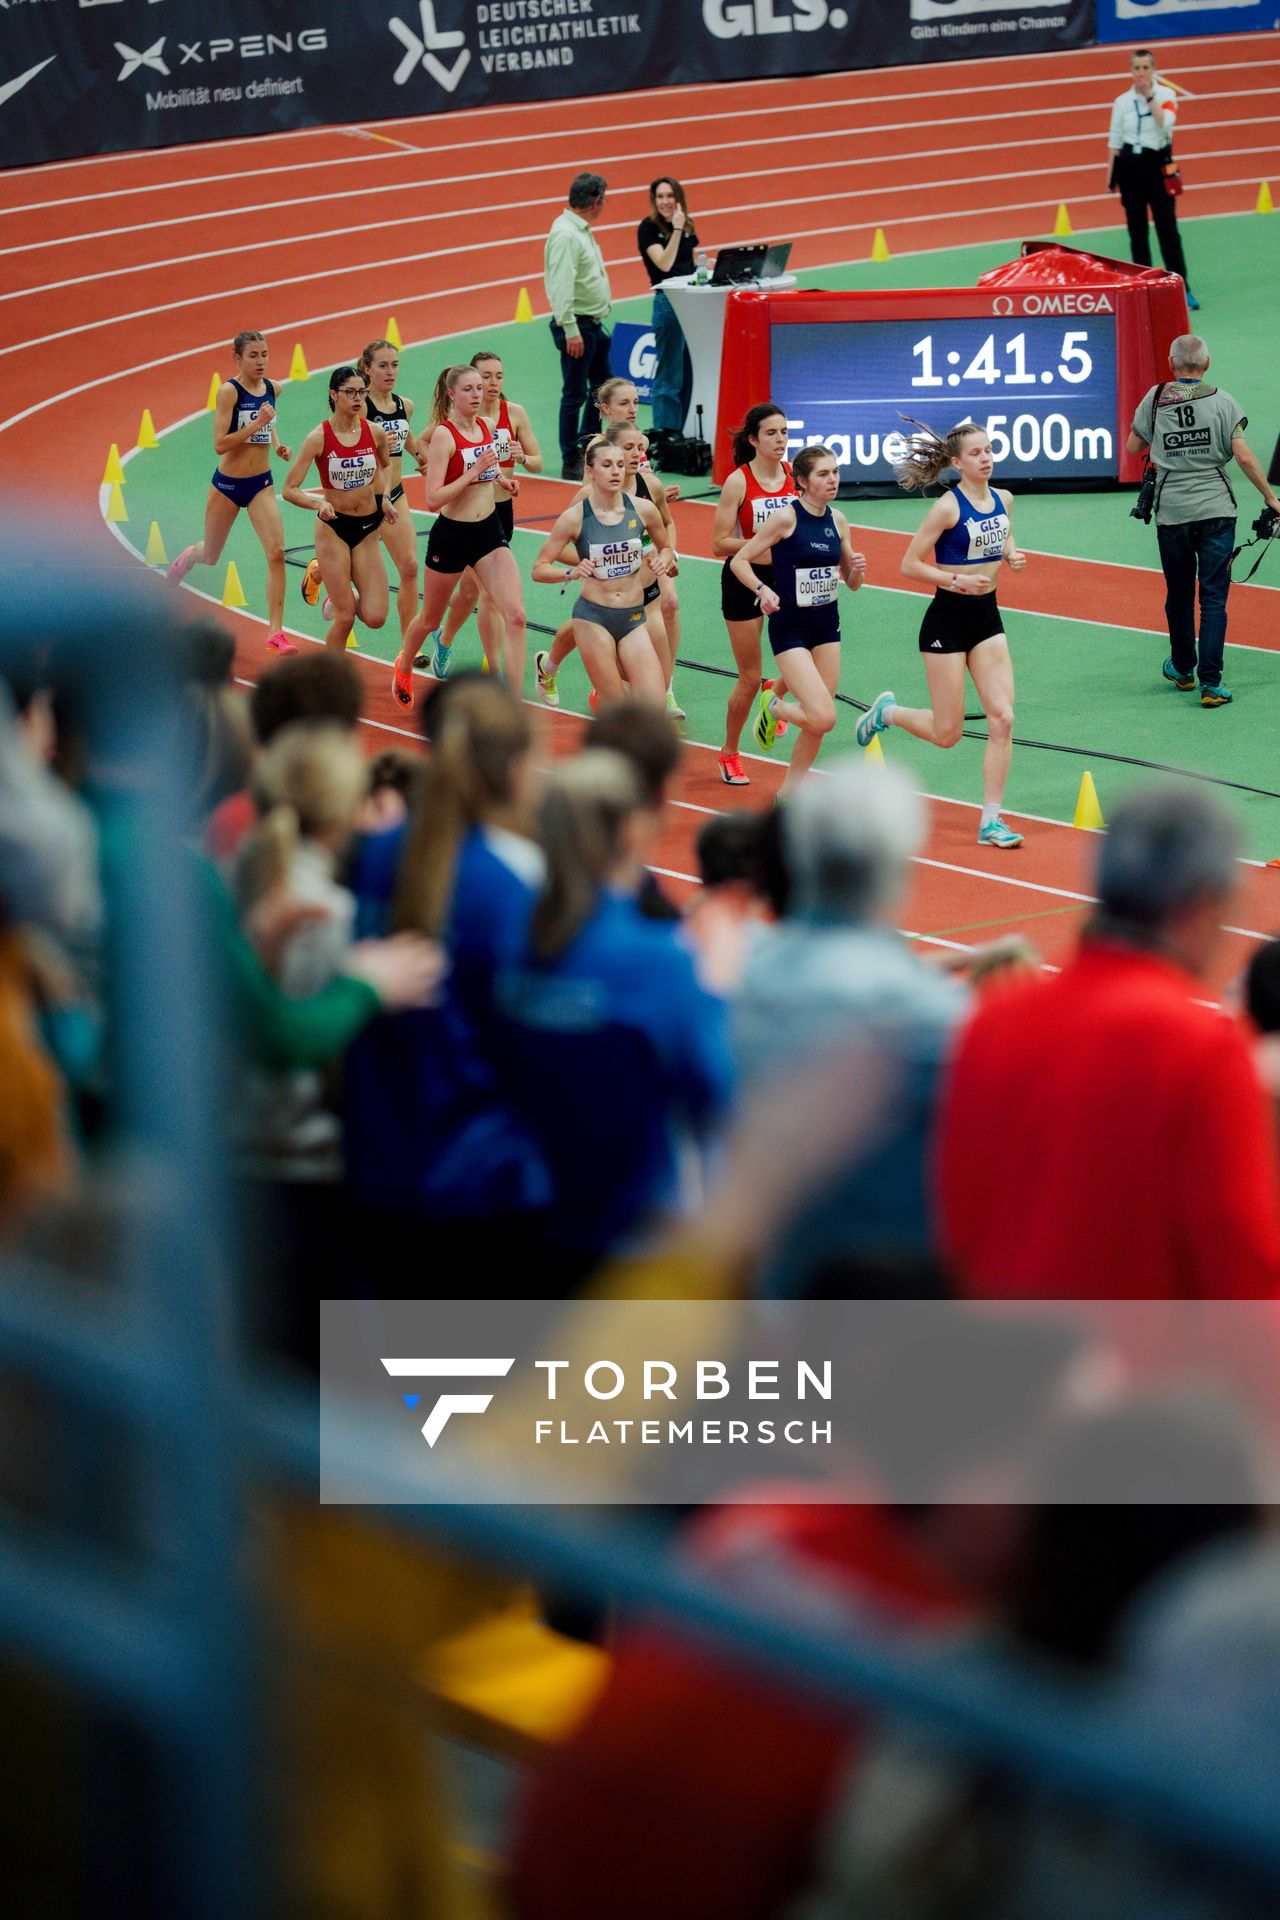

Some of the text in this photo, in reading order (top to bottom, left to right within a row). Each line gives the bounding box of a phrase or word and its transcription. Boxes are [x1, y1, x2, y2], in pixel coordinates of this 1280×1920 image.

[477, 0, 593, 23] DEUTSCHER
[479, 14, 641, 48] LEICHTATHLETIK
[1018, 16, 1067, 30] Chance
[178, 28, 328, 64] XPENG
[480, 47, 574, 73] VERBAND
[146, 77, 304, 110] Mobilität neu definiert
[1023, 293, 1113, 314] OMEGA
[911, 331, 1092, 387] 1:41.5
[1174, 405, 1195, 428] 18
[955, 413, 1112, 463] 500m
[1182, 431, 1209, 441] PLAN
[340, 457, 365, 469] GLS
[331, 470, 354, 482] WOLFF
[764, 498, 789, 509] GLS
[980, 517, 1000, 533] GLS
[602, 541, 629, 555] GLS
[975, 527, 1007, 548] BUDDE
[809, 568, 832, 580] GLS
[799, 579, 838, 594] COUTELLIER
